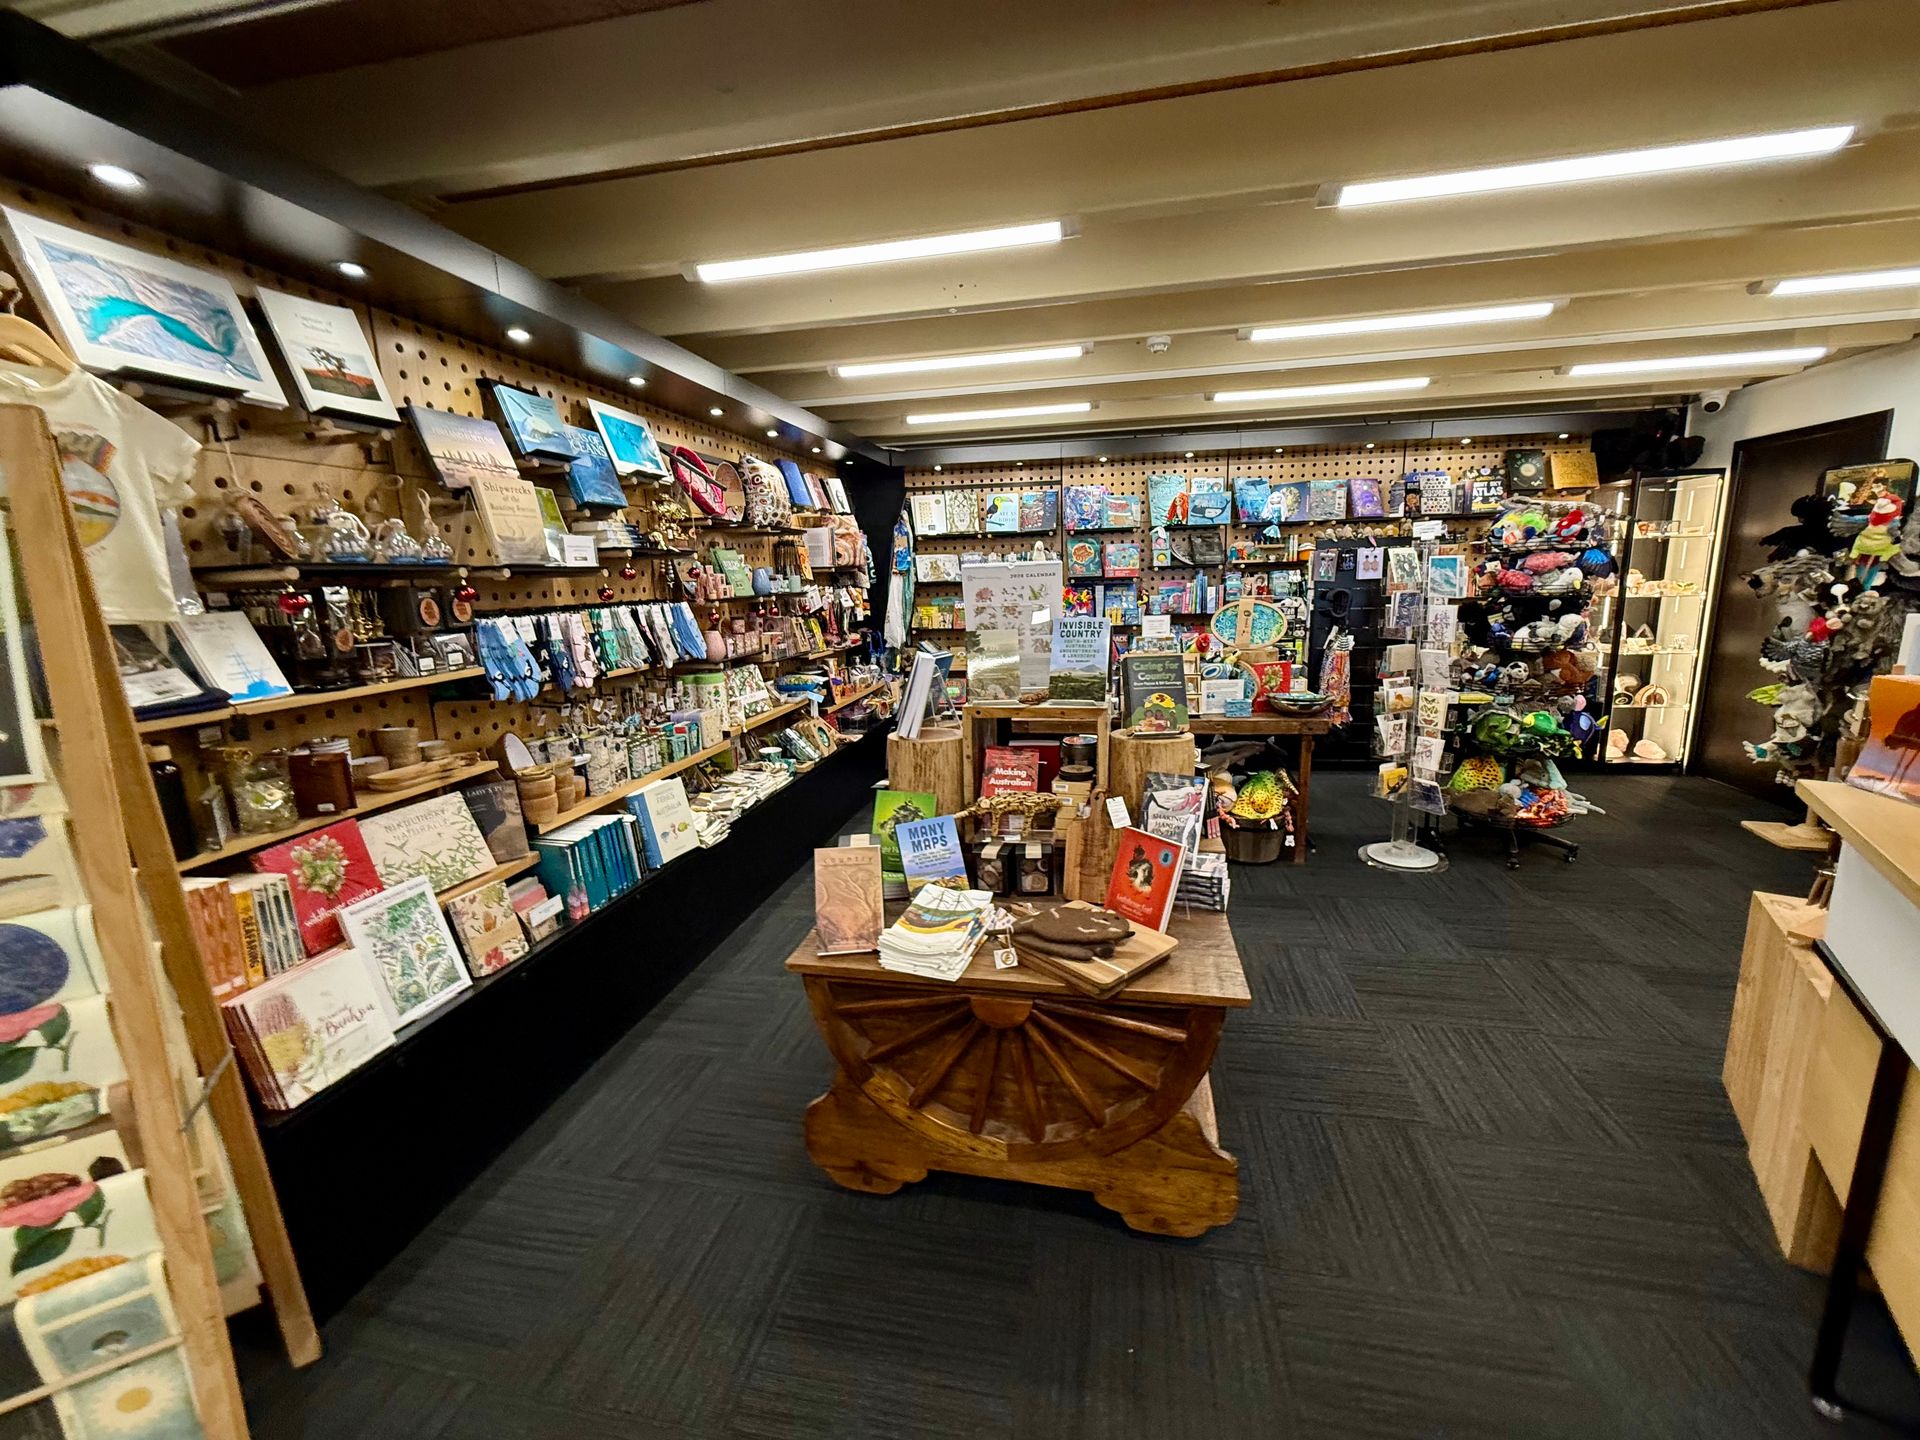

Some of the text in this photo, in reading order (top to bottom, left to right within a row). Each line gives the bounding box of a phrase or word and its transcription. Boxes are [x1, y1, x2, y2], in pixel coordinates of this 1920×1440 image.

[482, 481, 532, 496] Shipwrecks
[1472, 487, 1503, 497] ATLAS
[1059, 621, 1104, 630] INVISIBLE
[1060, 630, 1102, 638] COUNTRY
[1132, 660, 1180, 672] Caring for
[1137, 672, 1176, 681] Country
[995, 767, 1027, 777] Making
[989, 778, 1032, 786] Australian
[908, 822, 945, 840] MANY
[911, 835, 948, 853] MAPS
[347, 886, 380, 906] country
[241, 915, 261, 969] SEAFARING
